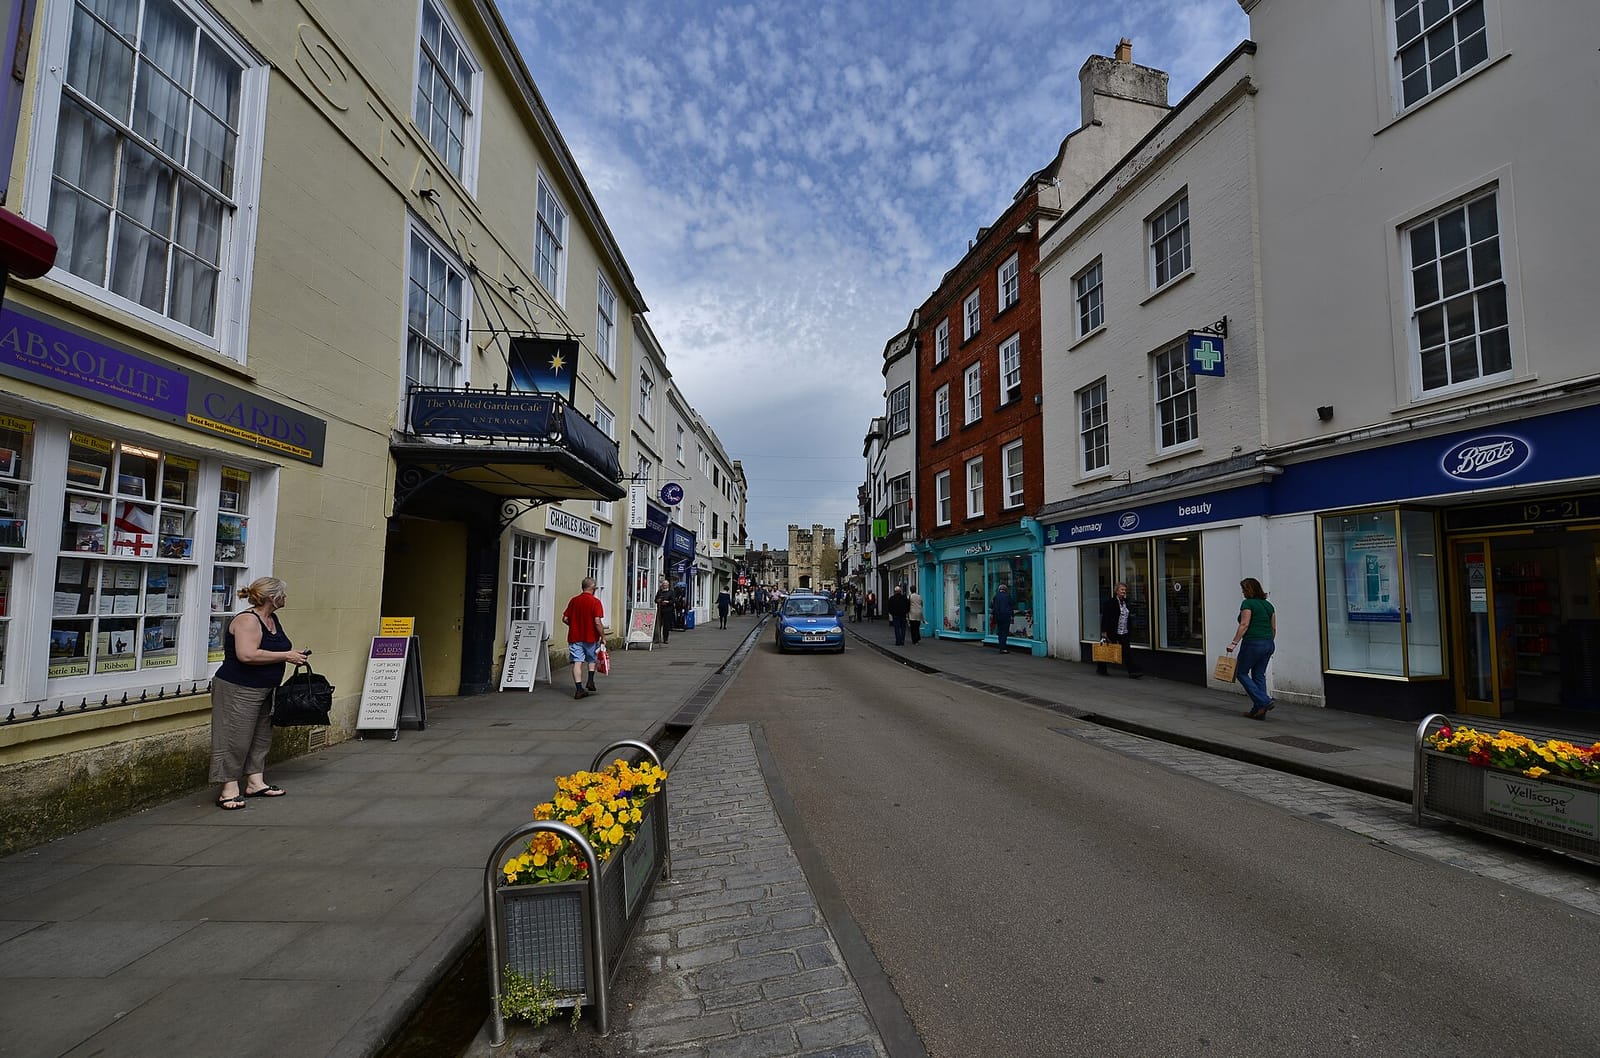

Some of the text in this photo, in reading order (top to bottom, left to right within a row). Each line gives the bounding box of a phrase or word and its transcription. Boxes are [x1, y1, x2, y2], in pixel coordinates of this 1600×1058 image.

[0, 326, 170, 401] ABSOLUTE
[15, 352, 27, 363] You
[425, 398, 445, 409] The
[447, 399, 481, 410] Walled
[483, 401, 519, 412] Garden
[204, 392, 307, 446] CARDS
[472, 416, 530, 427] ENTRANCE
[215, 422, 241, 437] Independent
[1452, 441, 1514, 474] Boots
[1179, 501, 1212, 517] beauty
[550, 511, 599, 539] CHARLES ASHLEY
[1071, 522, 1102, 536] pharmacy
[505, 624, 523, 684] CHARLES ASHLEY
[70, 665, 87, 674] Bags
[104, 661, 129, 671] Ribbon
[145, 658, 172, 667] Banners
[1506, 784, 1567, 807] Wellscope
[1555, 806, 1567, 816] ltd.
